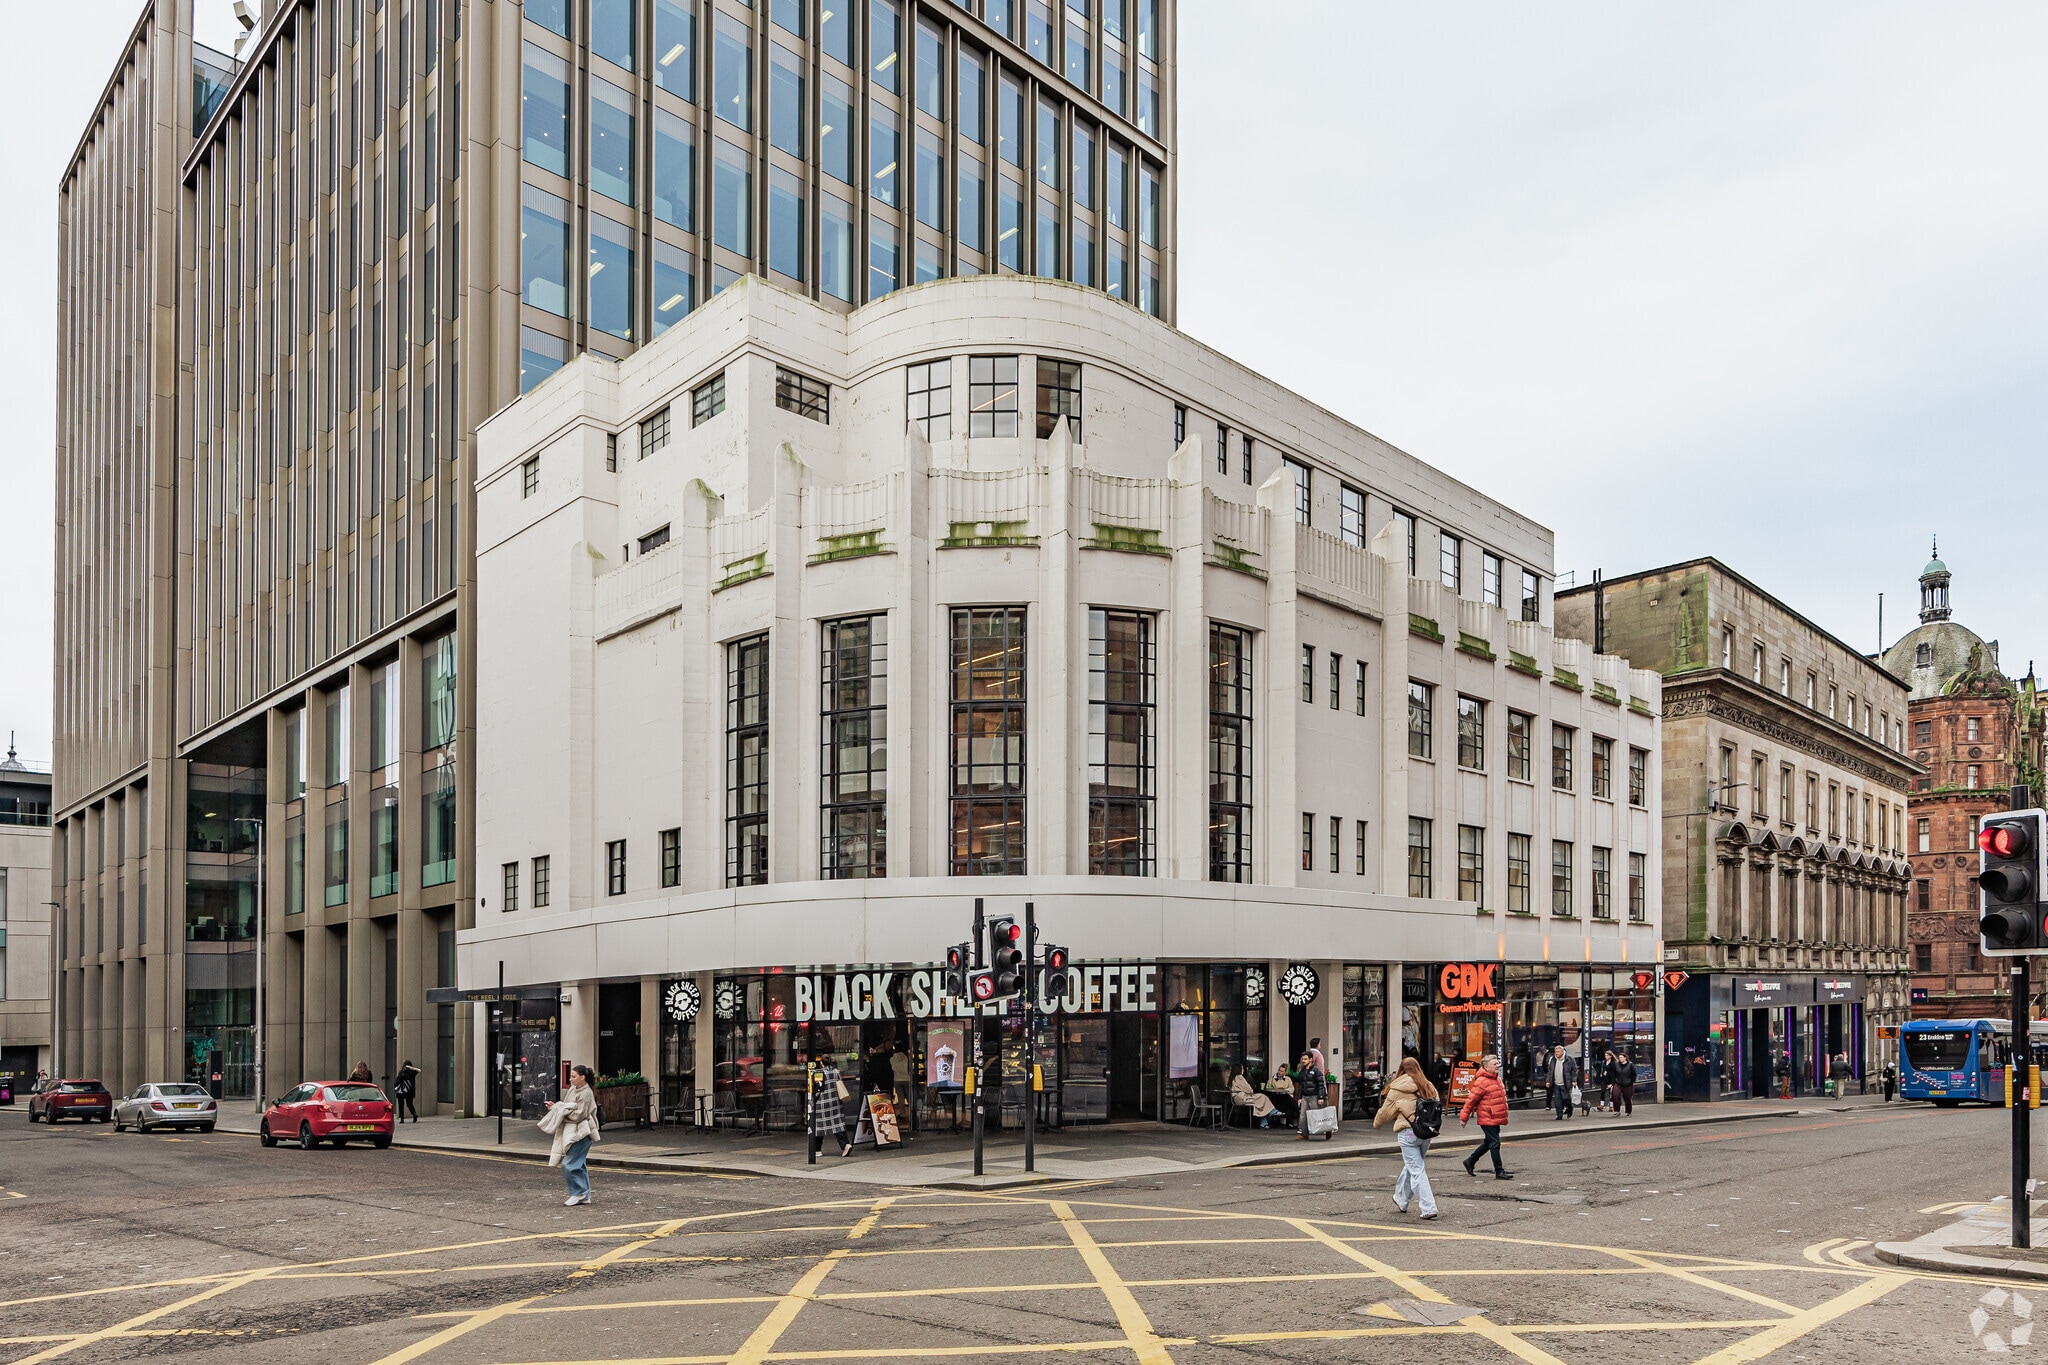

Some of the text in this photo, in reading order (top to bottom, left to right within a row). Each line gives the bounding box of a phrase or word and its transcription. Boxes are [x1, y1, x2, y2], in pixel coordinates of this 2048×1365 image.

[1282, 965, 1315, 990] BLACK SHEEP
[1441, 964, 1495, 998] GDK
[665, 981, 700, 1005] BLACK SHEEP
[795, 973, 895, 1021] BLACK
[1289, 988, 1314, 1006] COFFEE
[673, 1004, 698, 1020] COFFEE
